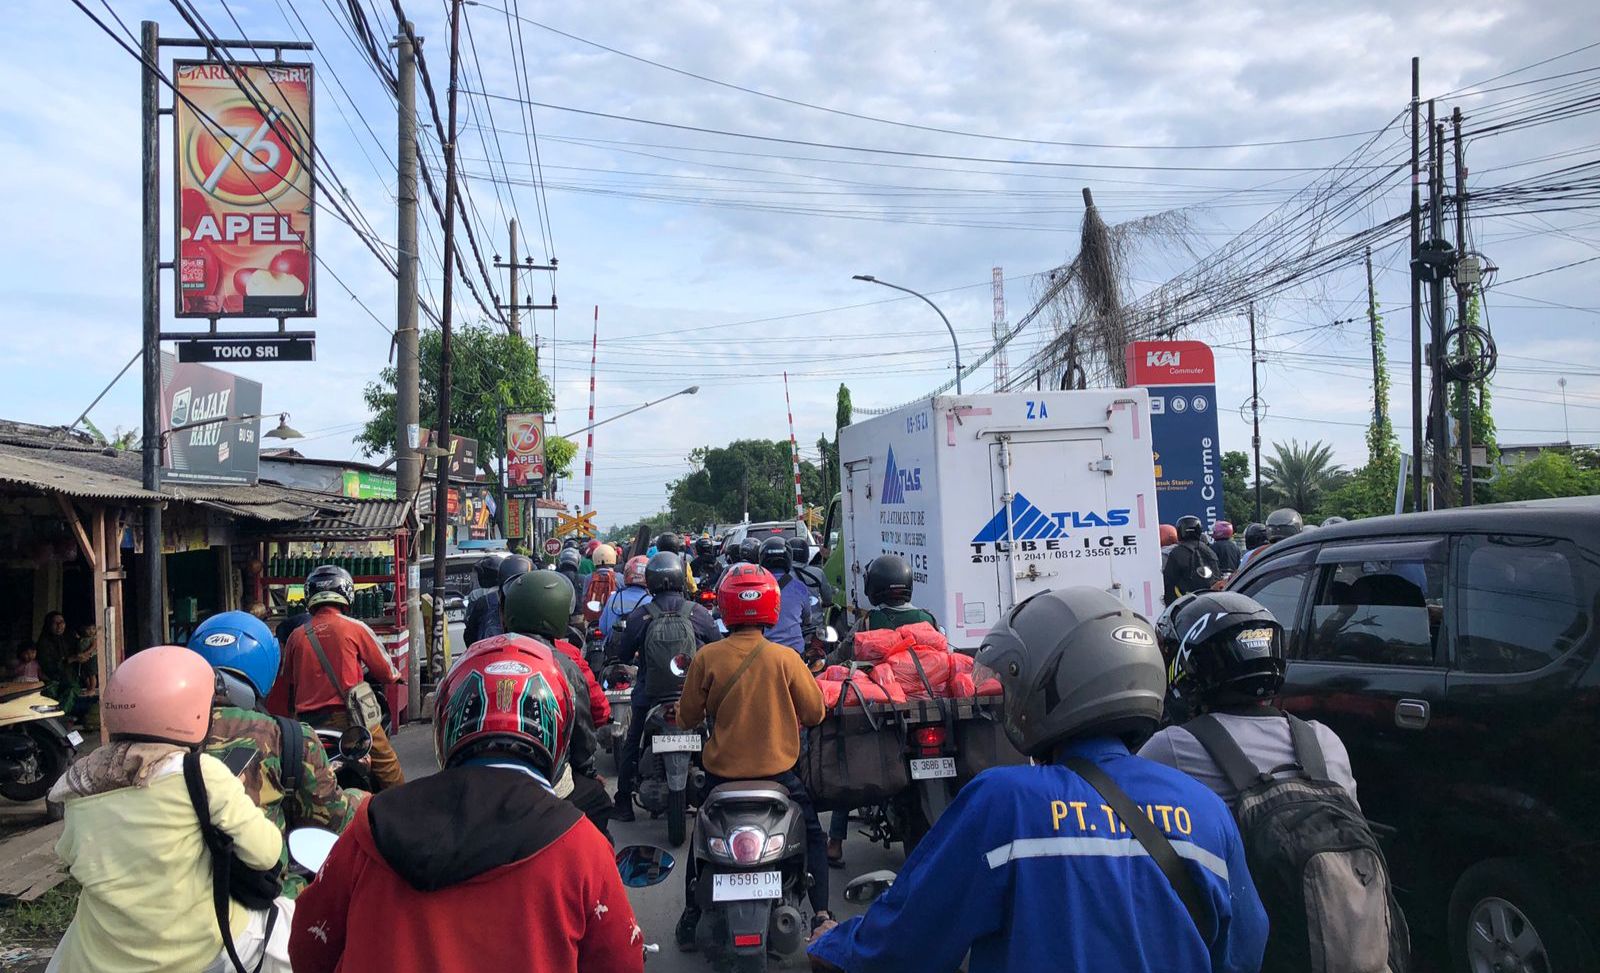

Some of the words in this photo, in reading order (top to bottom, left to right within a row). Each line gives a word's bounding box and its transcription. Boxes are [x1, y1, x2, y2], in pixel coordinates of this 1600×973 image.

[202, 106, 282, 195] 76
[193, 215, 302, 242] APEL
[213, 346, 251, 358] TOKO
[255, 346, 279, 358] SRI
[1146, 351, 1180, 367] KAI
[1169, 367, 1204, 375] Commuter
[191, 388, 231, 422] GAJAH
[189, 421, 223, 447] BARU
[512, 454, 541, 465] APEL
[1201, 437, 1215, 500] Cerme
[1083, 535, 1137, 549] ICE
[910, 553, 928, 570] ICE
[1024, 552, 1046, 561] 2041
[1055, 550, 1082, 560] 0812
[1085, 548, 1111, 558] 3556
[1113, 546, 1138, 556] 5211
[912, 761, 918, 771] S
[942, 759, 953, 769] EW
[1050, 800, 1097, 832] PT.
[1101, 803, 1193, 836] TTO
[715, 875, 723, 887] W
[729, 873, 759, 886] 6596
[764, 872, 780, 885] DM
